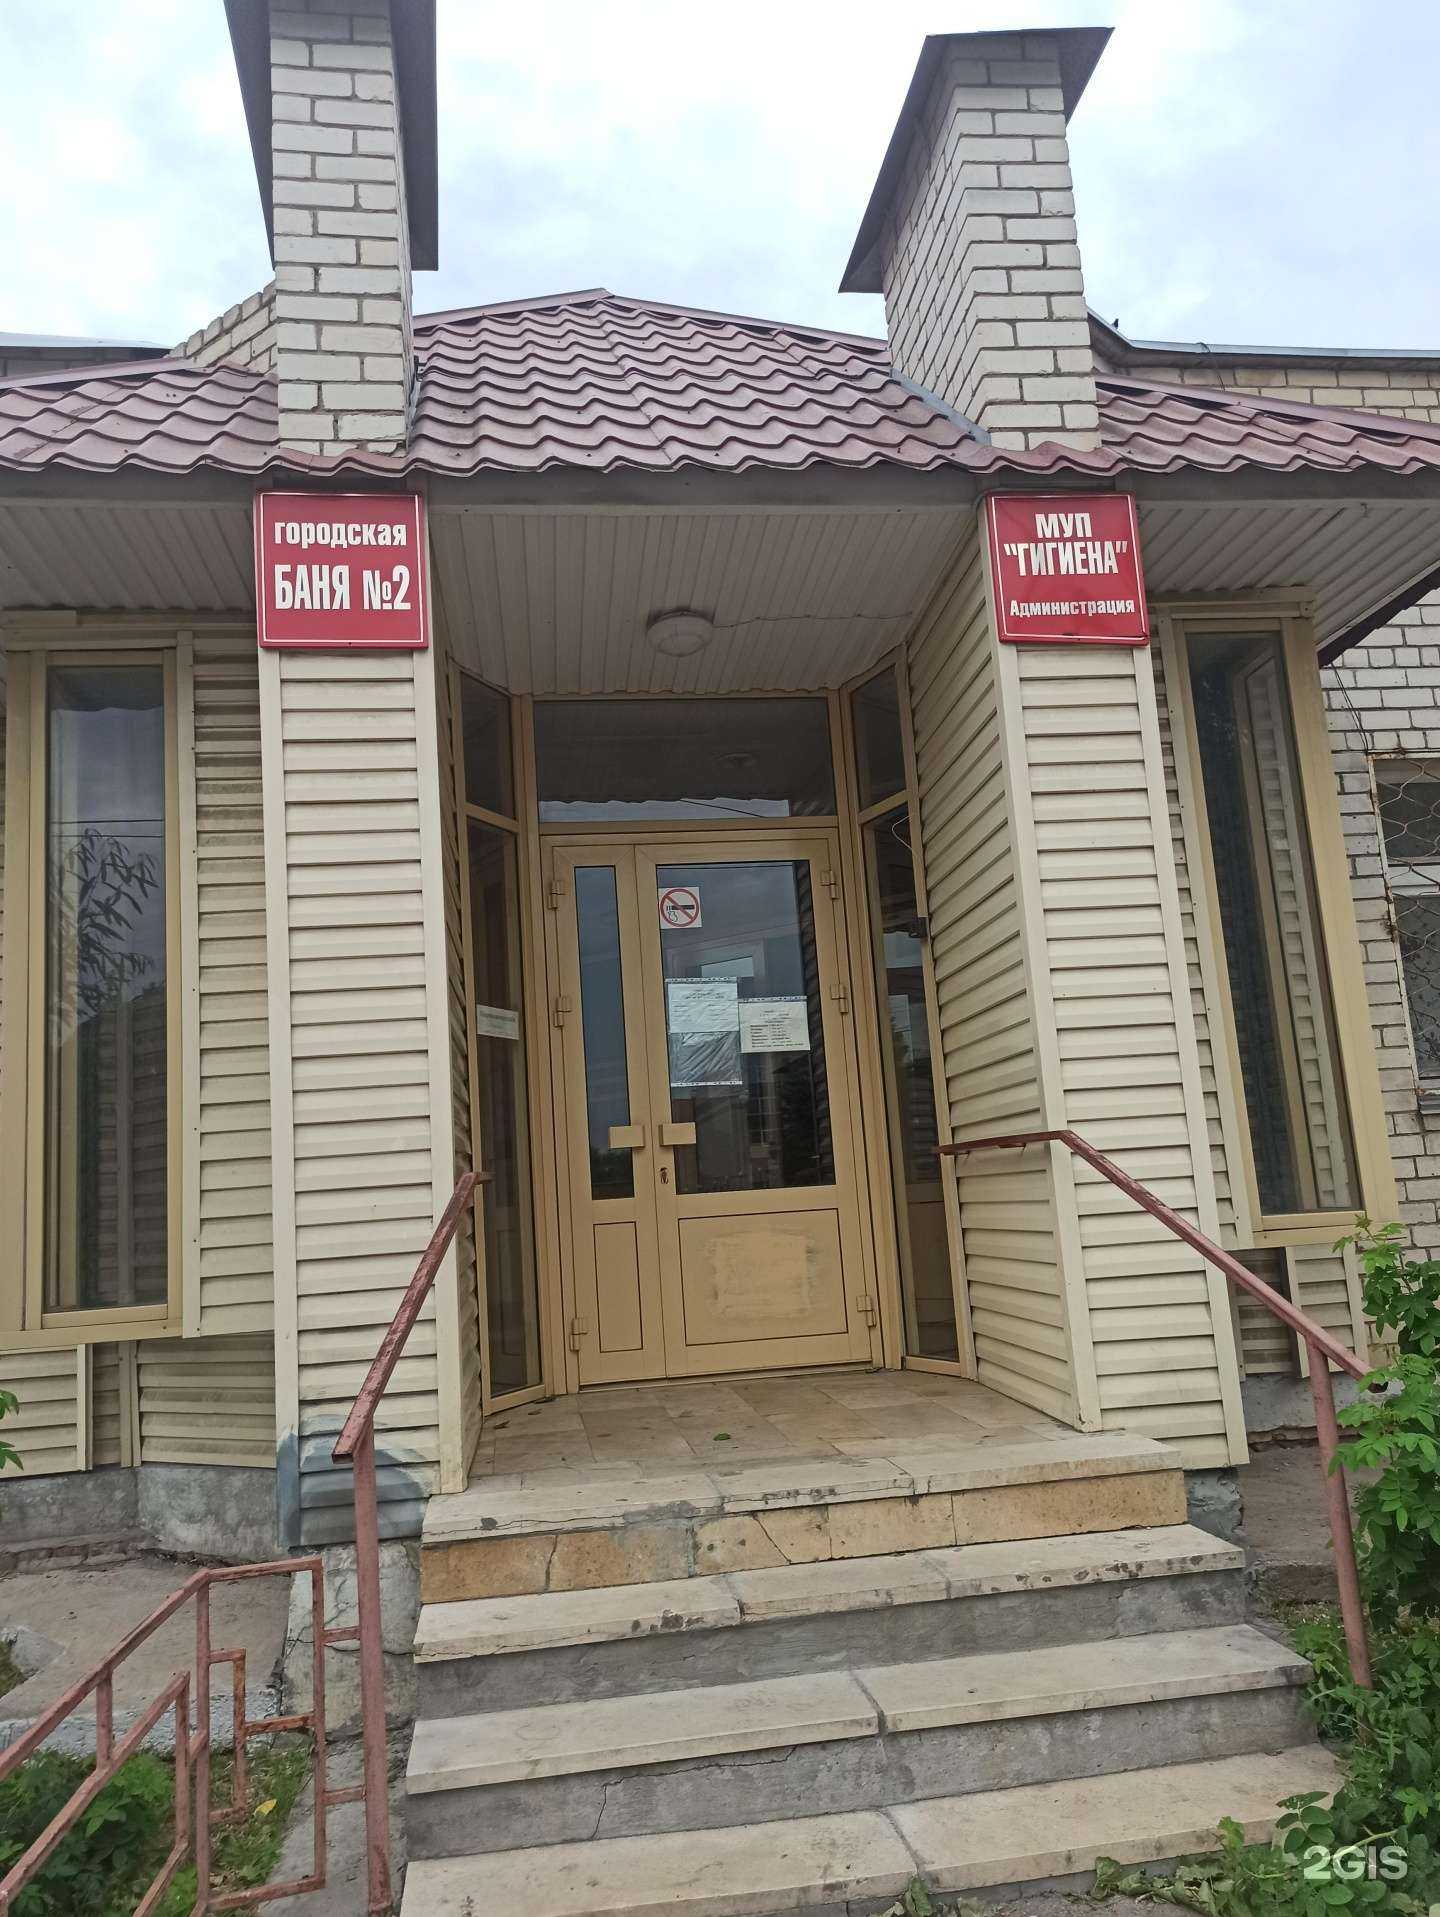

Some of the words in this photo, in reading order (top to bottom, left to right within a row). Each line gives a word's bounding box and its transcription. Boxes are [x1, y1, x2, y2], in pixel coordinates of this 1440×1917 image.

[274, 521, 407, 549] городская
[1035, 512, 1093, 539] МУП
[1003, 540, 1128, 577] "ГИГИЕНА"
[274, 564, 351, 610] БАНЯ
[362, 564, 412, 611] №2
[1009, 599, 1136, 618] Администрация
